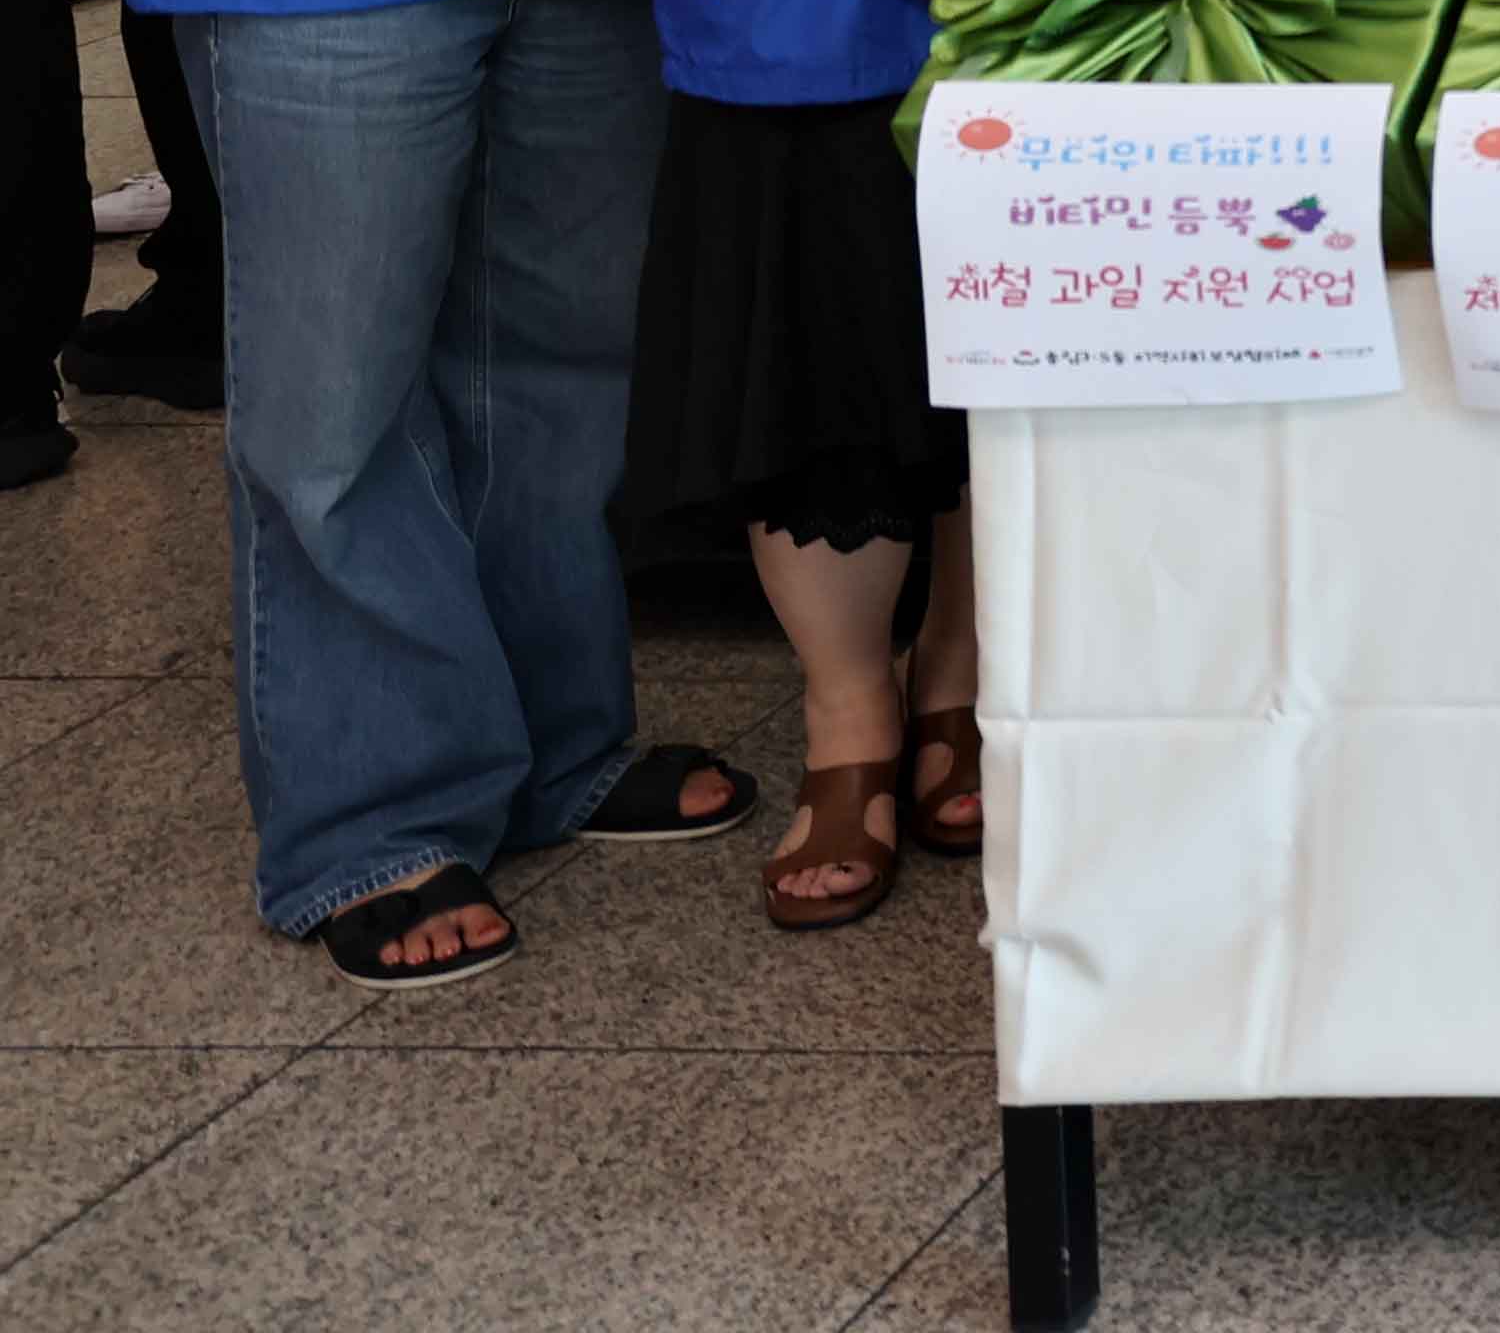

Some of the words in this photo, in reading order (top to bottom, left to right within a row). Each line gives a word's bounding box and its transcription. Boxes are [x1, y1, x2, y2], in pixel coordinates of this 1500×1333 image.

[1020, 137, 1157, 172] 무더위
[1165, 133, 1332, 168] 타파!!!
[1007, 194, 1156, 232] 비타민
[944, 262, 1035, 309] 제철
[1050, 263, 1146, 311] 과일
[1164, 264, 1251, 310] 지원
[1266, 268, 1357, 309] 사업
